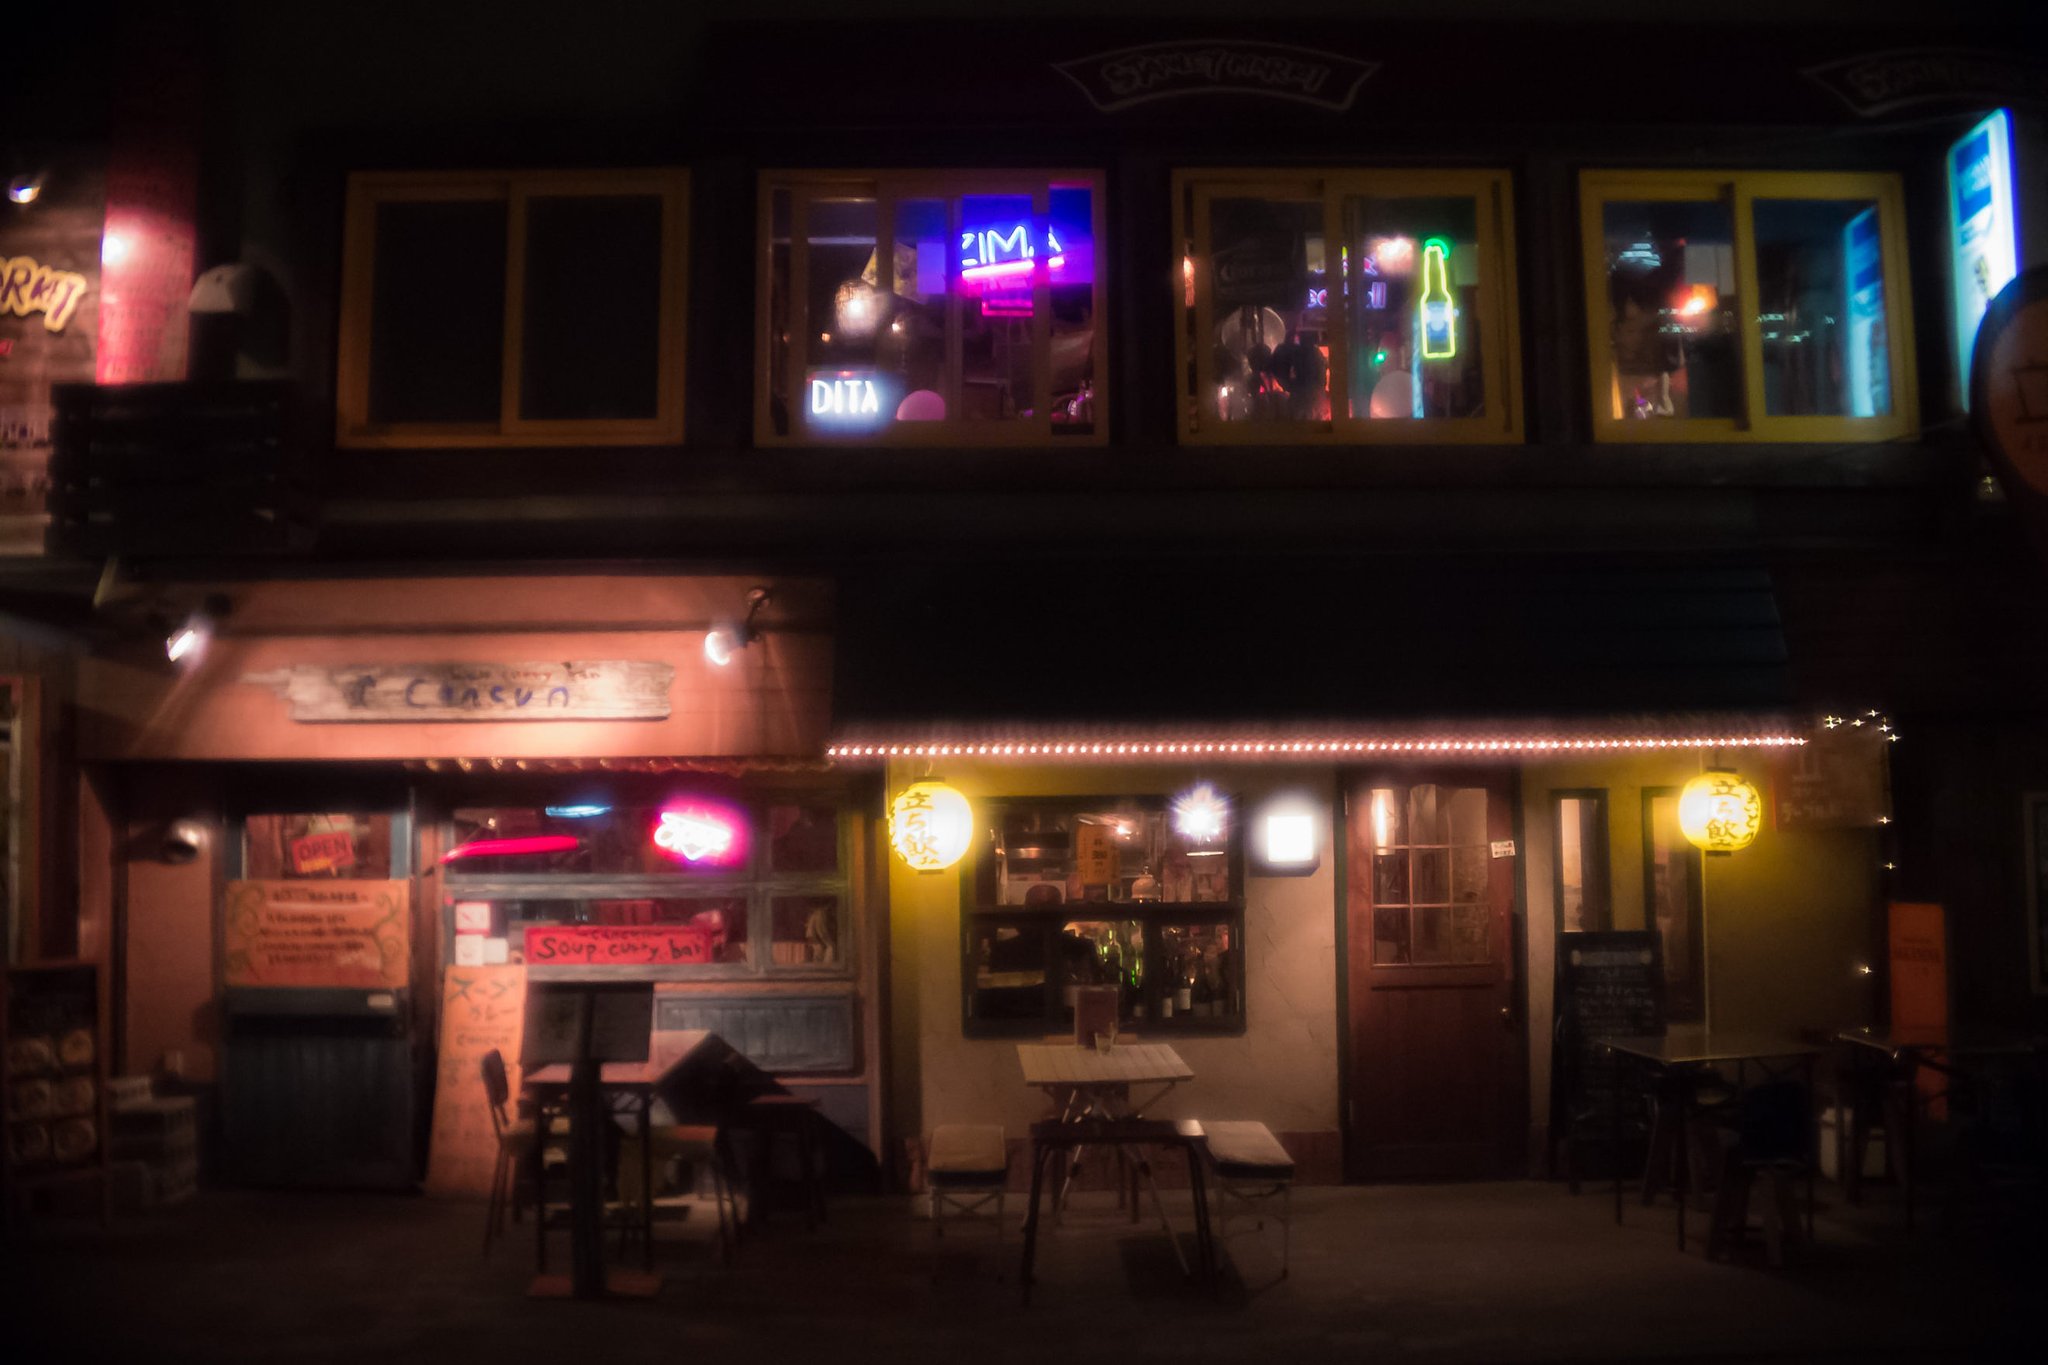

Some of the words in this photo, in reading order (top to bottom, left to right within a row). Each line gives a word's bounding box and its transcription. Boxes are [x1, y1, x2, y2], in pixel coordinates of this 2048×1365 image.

[0, 257, 87, 332] RKET
[811, 379, 880, 415] DITA
[300, 838, 348, 860] OPEN
[536, 937, 597, 962] Soup
